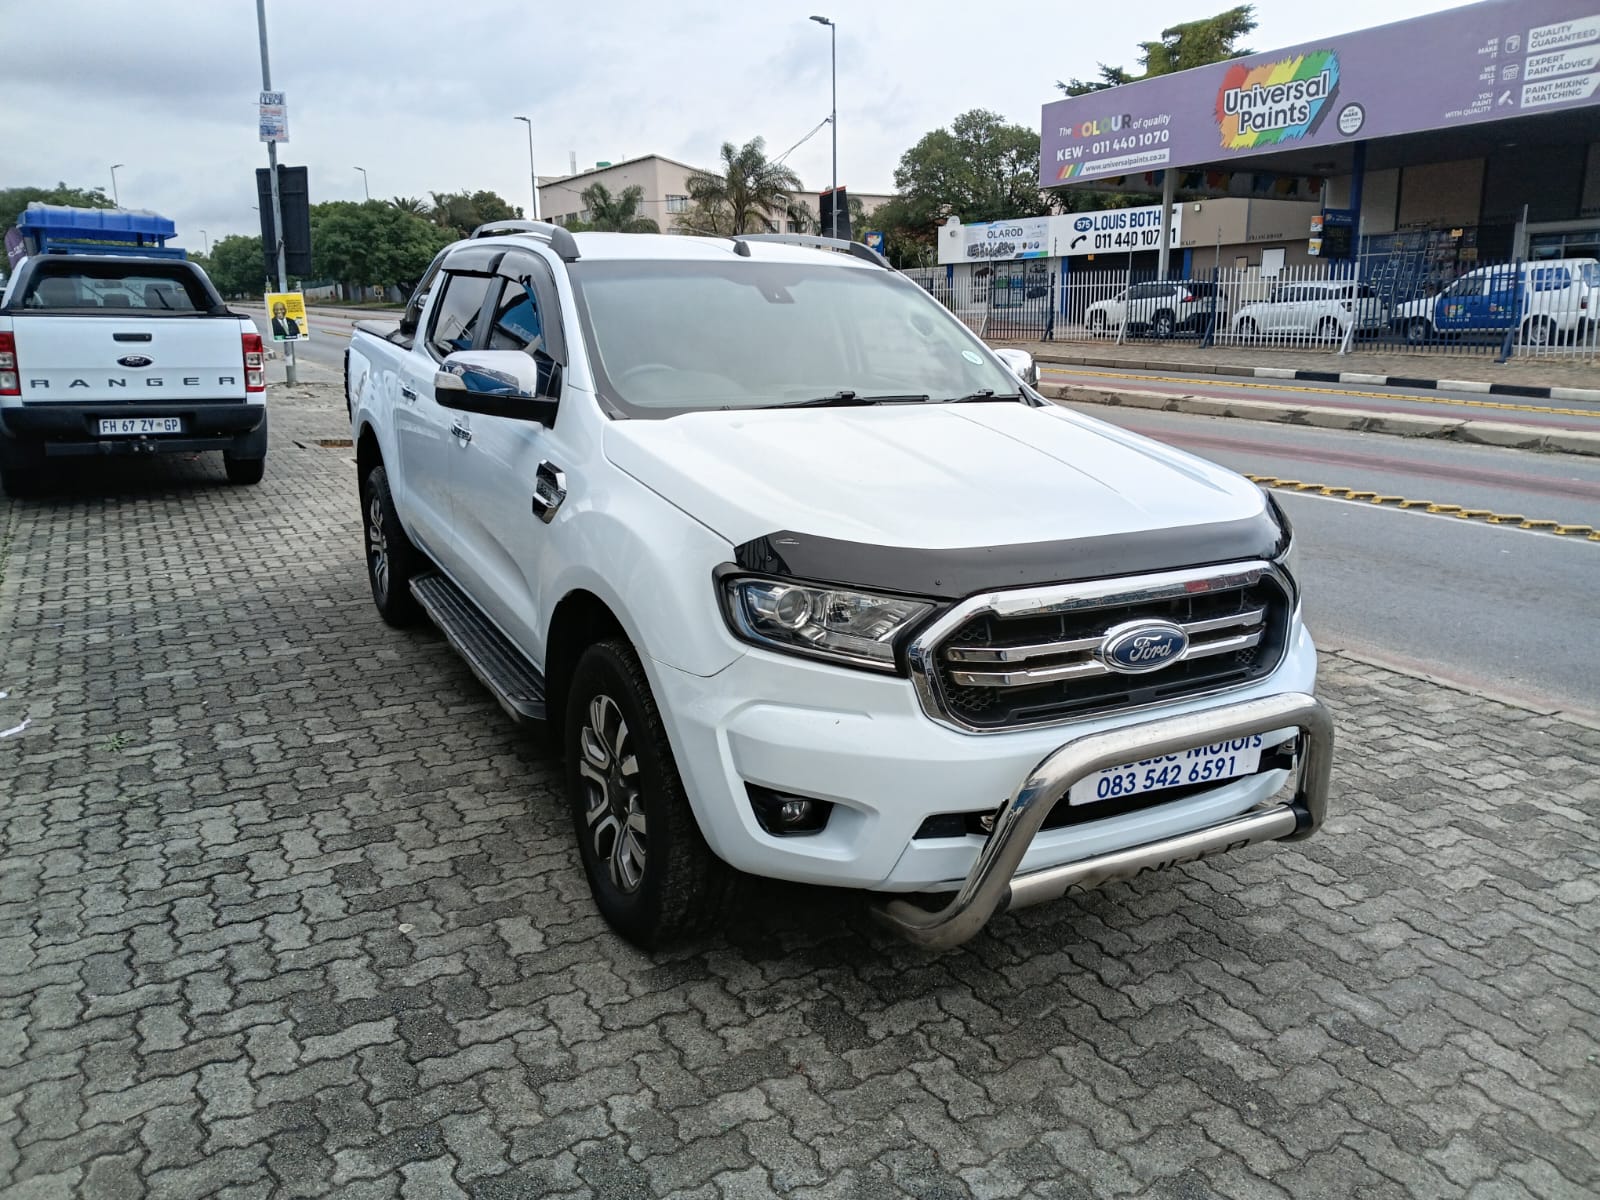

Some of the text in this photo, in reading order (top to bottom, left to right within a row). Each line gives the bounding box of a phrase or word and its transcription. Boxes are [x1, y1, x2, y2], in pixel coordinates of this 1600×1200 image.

[1530, 28, 1597, 48] GUARANTEED
[1531, 24, 1573, 39] QUALITY
[1527, 57, 1594, 77] PAINT ADVICE
[1528, 54, 1566, 67] EXPERT
[1225, 70, 1329, 113] Universal
[1524, 87, 1583, 104] & MATCHING
[1525, 77, 1590, 95] PAINT MIXING
[1471, 98, 1493, 108] PAINT
[1478, 92, 1493, 100] YOU
[1240, 101, 1309, 133] Paints
[1445, 105, 1492, 119] WITH QUALITY
[1059, 113, 1172, 139] The COLOUR of quality
[1056, 145, 1084, 162] KEW
[1092, 140, 1110, 155] 011
[1112, 136, 1136, 150] 440
[1139, 129, 1170, 146] 1070
[1085, 153, 1167, 172] www.universalpaints.co.za
[1076, 210, 1161, 232] 575 LOUIS BOTH
[987, 227, 1024, 239] OLAROD
[1094, 233, 1112, 249] 011
[1114, 231, 1138, 247] 440
[1141, 227, 1177, 246] 1071
[30, 376, 236, 389] RANGER
[102, 418, 178, 432] FH 67 ZY GP
[1129, 634, 1174, 662] Ford
[1097, 771, 1137, 799] 083
[1142, 764, 1182, 790] 542
[1187, 755, 1236, 783] 6591
